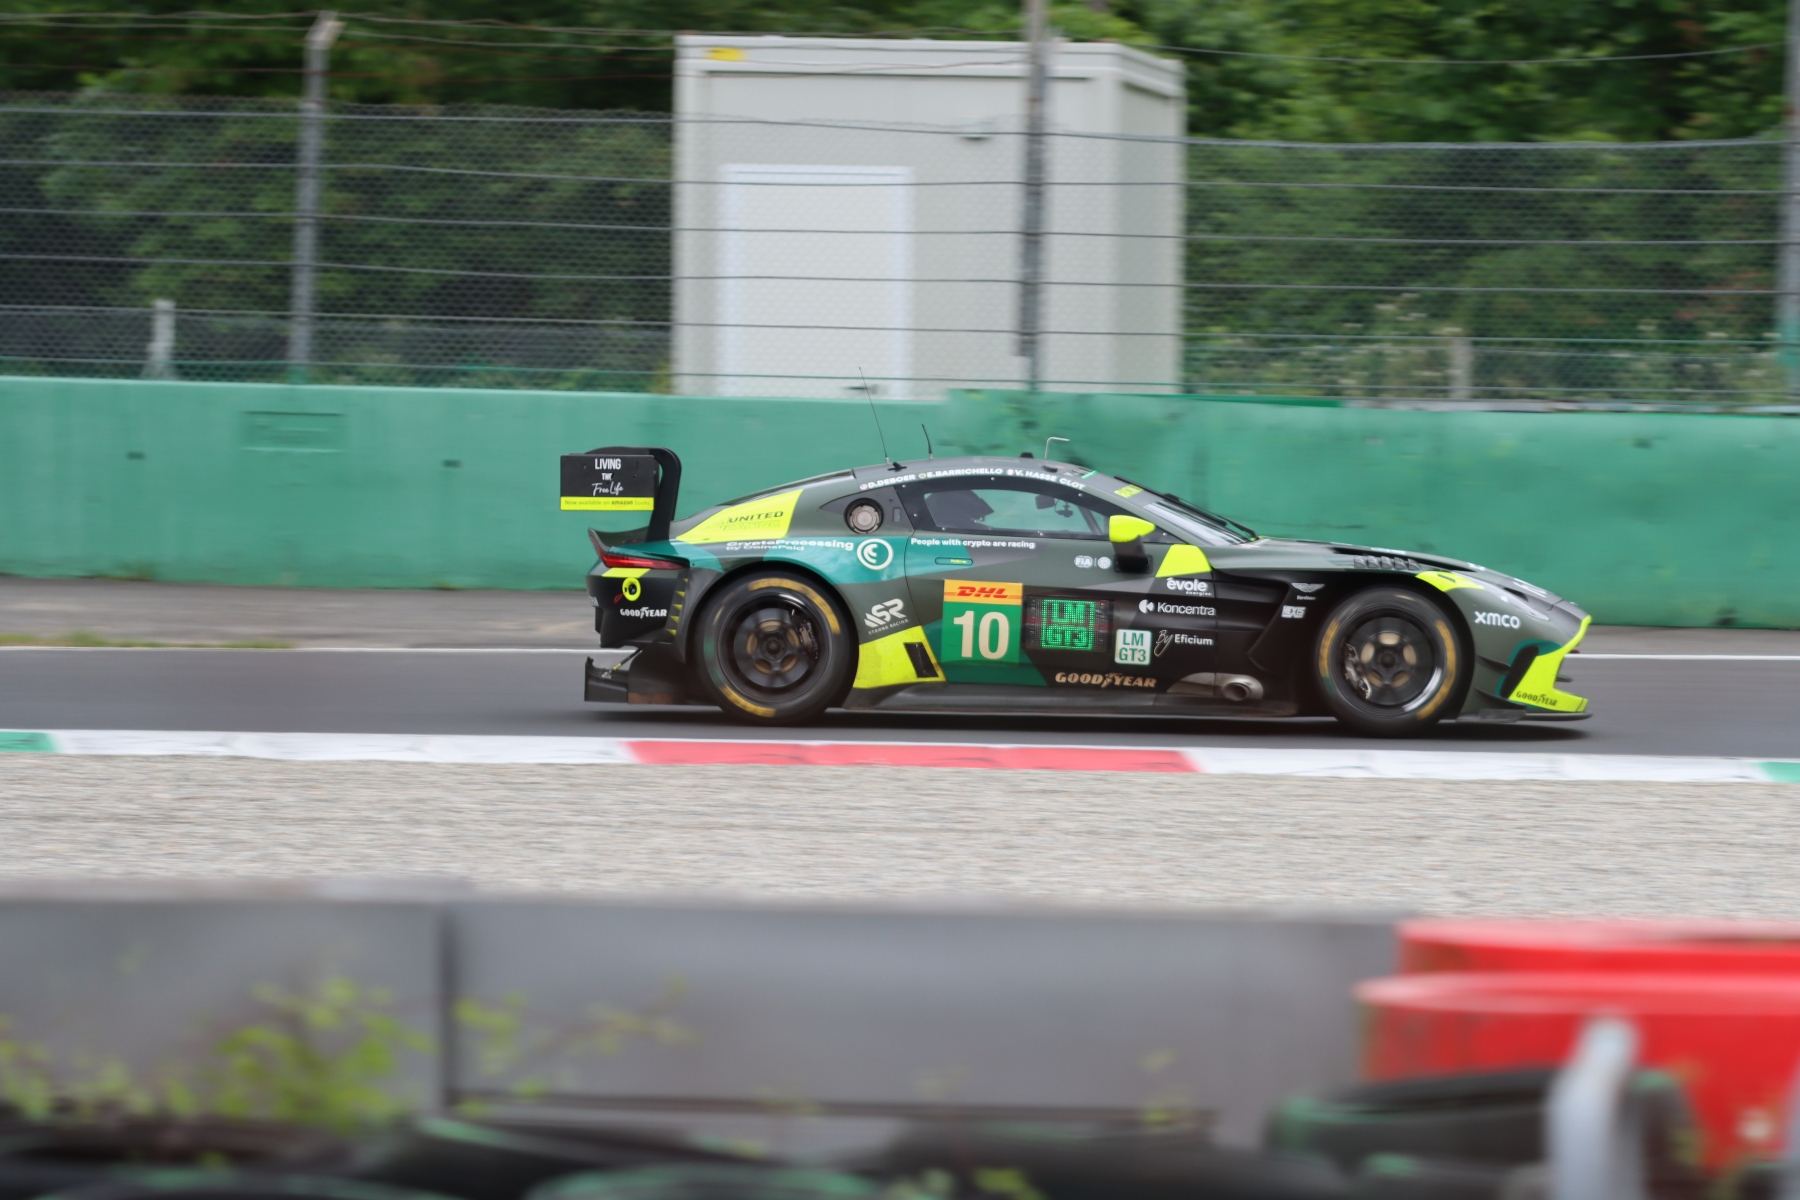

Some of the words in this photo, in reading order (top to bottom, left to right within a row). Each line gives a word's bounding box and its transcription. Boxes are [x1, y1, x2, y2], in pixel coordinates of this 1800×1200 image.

[595, 458, 621, 470] LIVING
[867, 474, 916, 489] D.DEBOER
[927, 468, 1003, 478] E.BARRICHELLO
[1015, 469, 1024, 477] V.
[1025, 471, 1057, 481] HASSE
[1059, 477, 1085, 489] CLOT
[729, 511, 783, 523] UNITED
[722, 520, 780, 531] RACING
[726, 539, 854, 551] CryptoProcessing
[910, 538, 940, 547] People
[962, 539, 991, 548] crypto
[1007, 540, 1036, 549] racing
[1166, 577, 1208, 592] évole
[956, 586, 1009, 598] DHL
[620, 607, 667, 619] GOODYEAR
[1052, 602, 1086, 623] LM
[1157, 602, 1215, 616] Koncentra
[1281, 605, 1306, 618] HEXIS
[868, 625, 889, 635] STRONG
[889, 618, 909, 628] RACING
[1474, 611, 1521, 629] xmco
[953, 610, 1010, 660] 10
[1123, 632, 1144, 646] LM
[1154, 630, 1173, 657] By
[1174, 634, 1213, 646] Eficium
[1118, 648, 1147, 662] GT3
[1055, 672, 1157, 688] GOODYEAR
[1516, 691, 1557, 706] GOODYEAR
